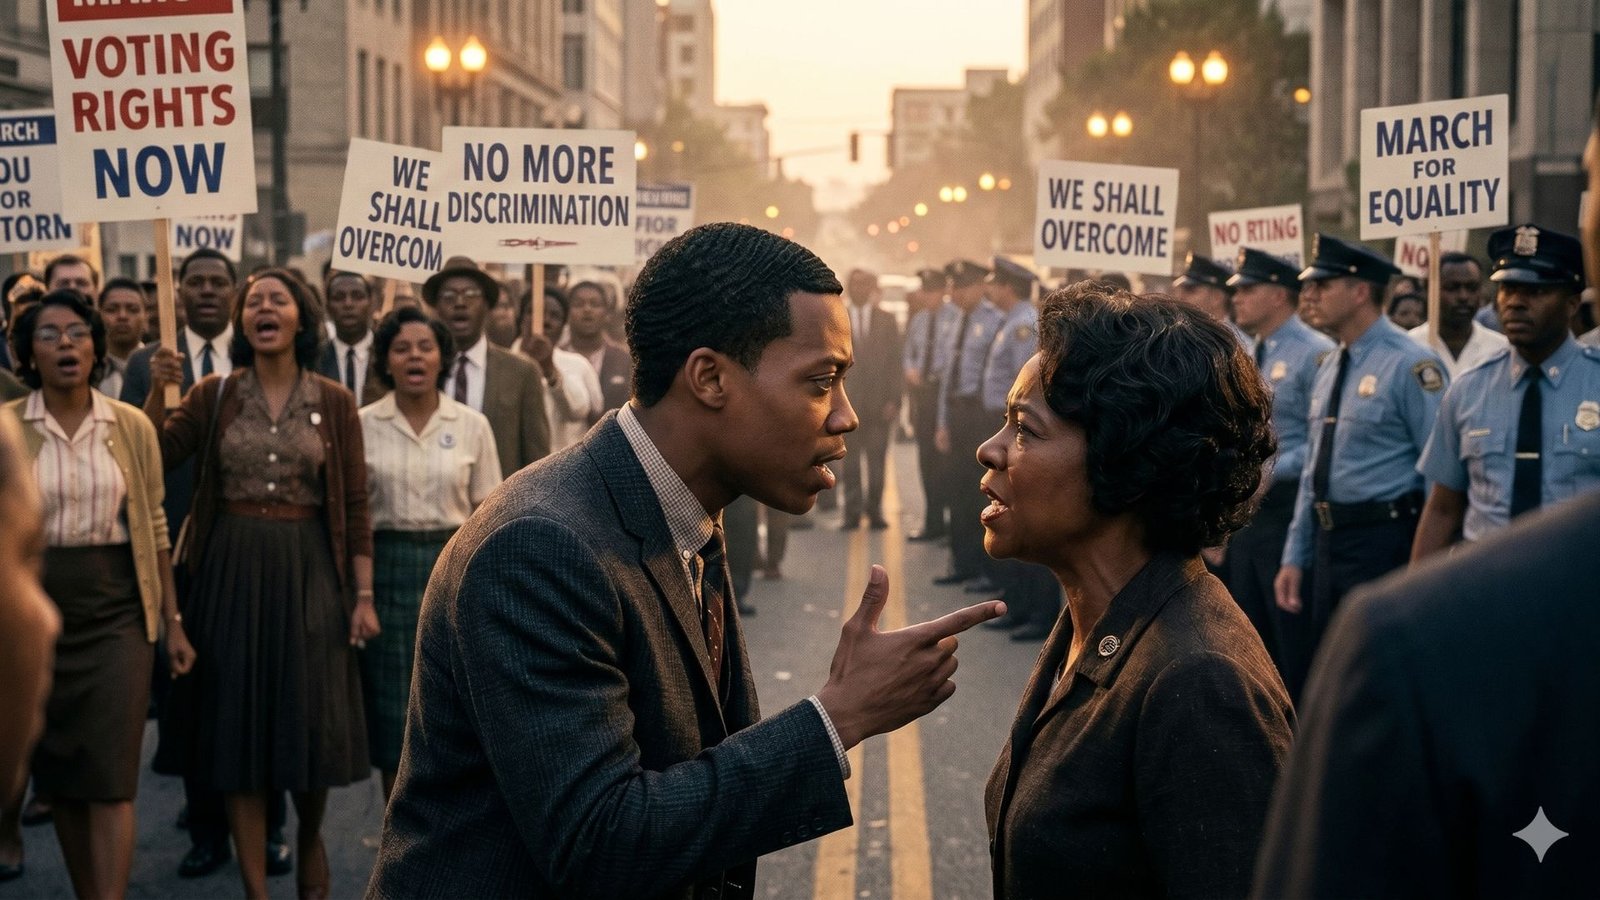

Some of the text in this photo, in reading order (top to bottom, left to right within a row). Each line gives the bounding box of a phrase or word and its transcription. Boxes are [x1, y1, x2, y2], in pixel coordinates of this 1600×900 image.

[62, 30, 234, 79] VOTING
[72, 84, 236, 132] RIGHTS
[1376, 109, 1492, 157] MARCH
[93, 142, 226, 199] NOW
[392, 155, 431, 192] WE
[464, 143, 615, 184] NO MORE
[1413, 158, 1456, 179] FOR
[368, 191, 442, 232] SHALL
[448, 191, 630, 227] DISCRIMINATION
[1049, 178, 1165, 217] WE SHALL
[1369, 177, 1501, 226] EQUALITY
[176, 224, 234, 249] NOW
[339, 226, 442, 272] OVERCOM
[1041, 218, 1168, 259] OVERCOME
[1214, 216, 1298, 245] NO RTING
[1401, 242, 1430, 268] NO
